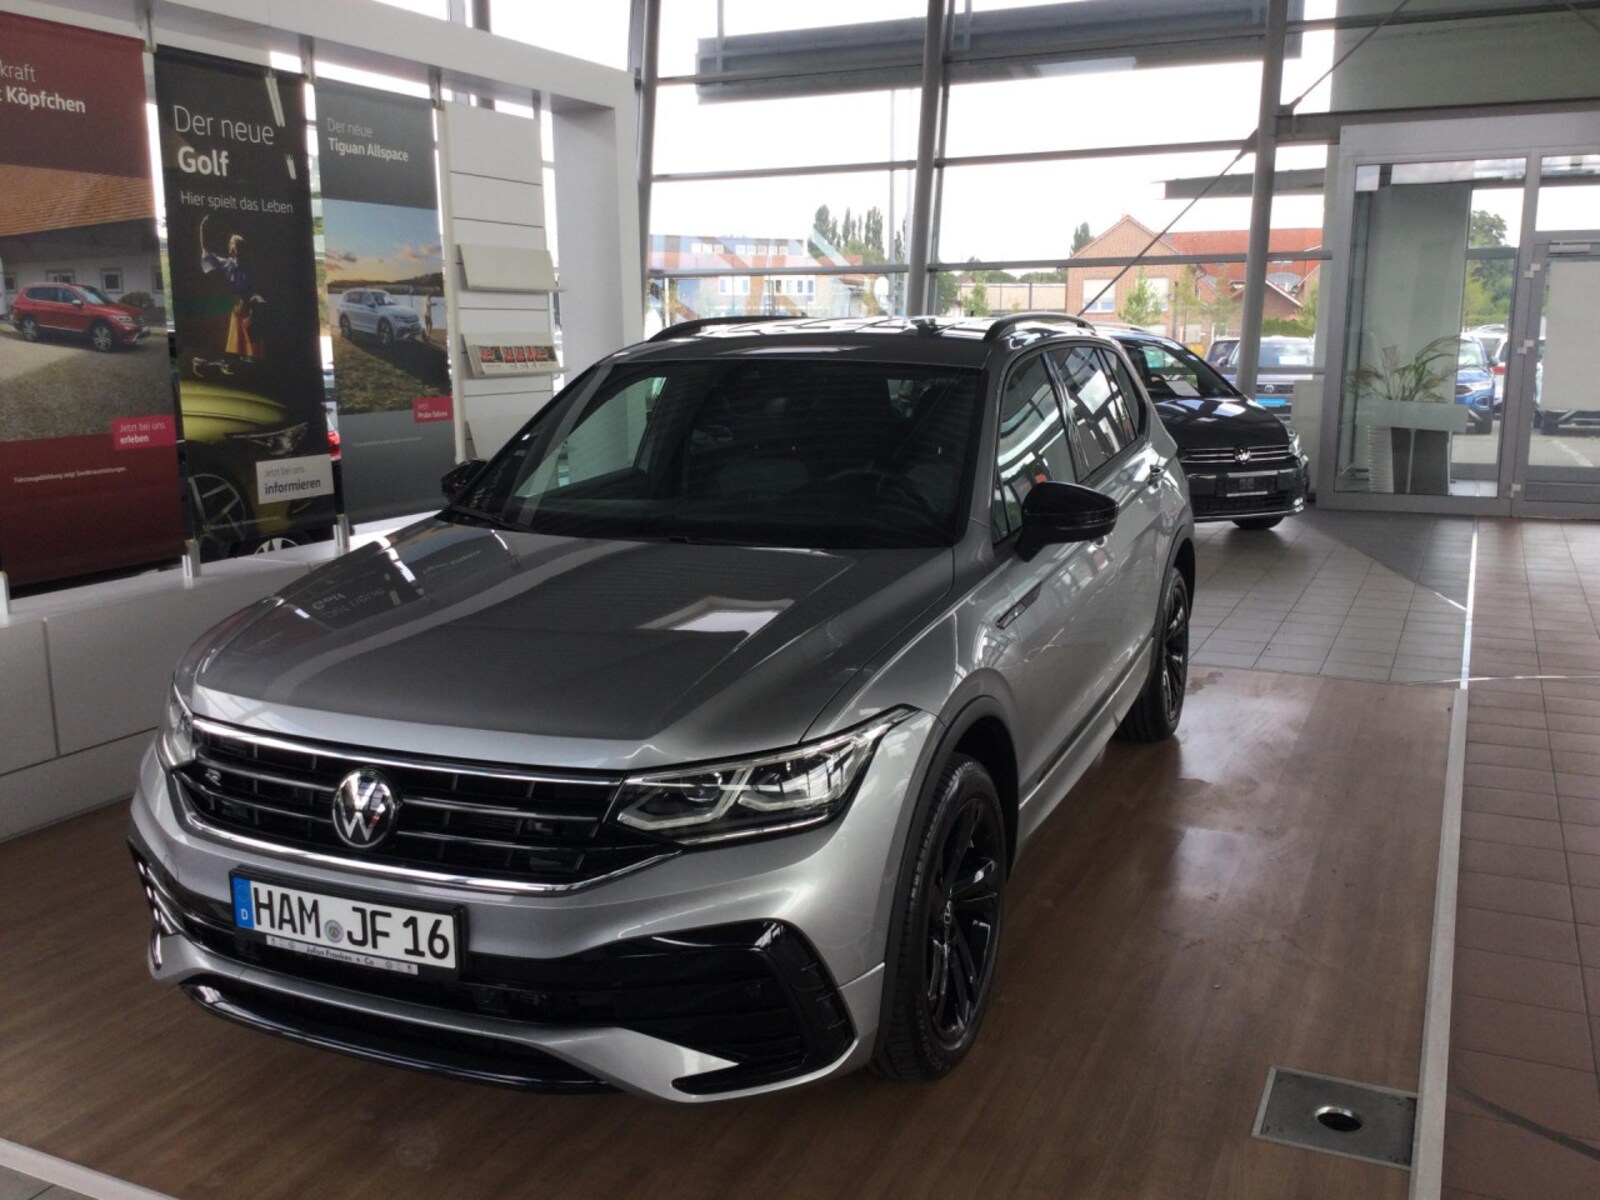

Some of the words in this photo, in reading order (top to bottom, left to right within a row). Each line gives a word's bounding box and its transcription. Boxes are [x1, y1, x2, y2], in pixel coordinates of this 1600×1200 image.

[6, 86, 86, 113] Köpfchen
[174, 104, 214, 136] Der
[220, 118, 275, 145] neue
[326, 117, 346, 133] Der
[347, 123, 374, 138] neue
[178, 145, 229, 177] Golf
[328, 137, 365, 156] Tiguan
[367, 143, 409, 162] Allspace
[180, 191, 206, 206] Hier
[207, 194, 237, 210] spielt
[239, 196, 258, 211] das
[261, 198, 294, 214] Leben
[120, 434, 150, 445] erleben
[264, 478, 321, 495] informieren
[240, 908, 248, 921] D
[253, 886, 321, 938] HAM
[347, 906, 392, 949] JF
[402, 916, 450, 960] 16
